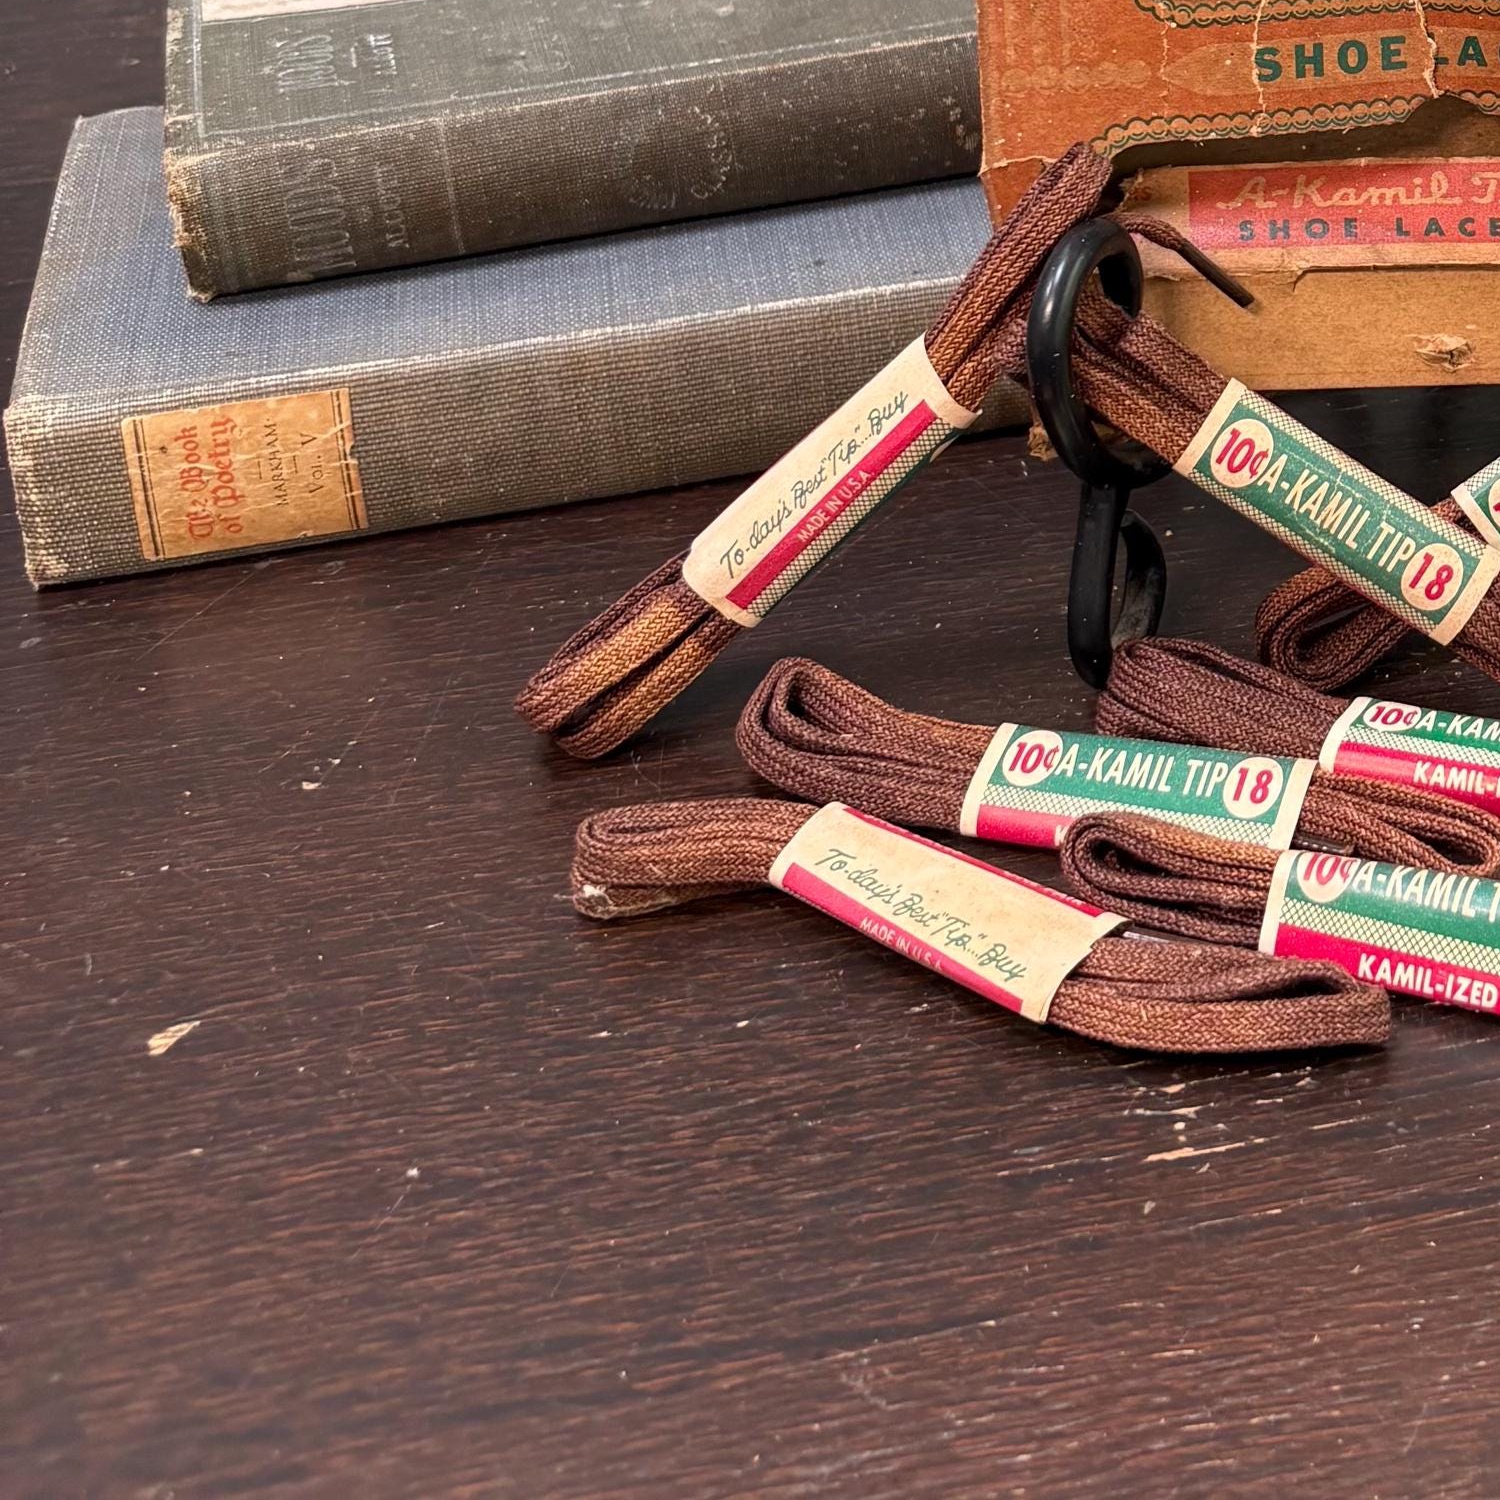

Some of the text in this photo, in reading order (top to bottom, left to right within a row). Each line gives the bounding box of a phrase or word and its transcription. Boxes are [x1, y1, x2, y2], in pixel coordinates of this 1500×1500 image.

[1253, 35, 1407, 82] SHOE
[1216, 170, 1463, 210] A-Kamil
[1238, 217, 1359, 242] SHOE
[174, 424, 209, 493] Book
[790, 464, 828, 509] Best
[867, 390, 909, 435] Buy
[218, 512, 244, 534] of
[797, 509, 831, 542] MADE
[825, 495, 844, 513] IN
[1215, 428, 1454, 601] 10¢ A-KAMIL TIP 18
[1369, 705, 1416, 727] 10¢
[1008, 741, 1274, 805] 10¢ A-KAMIL TIP 18
[1352, 861, 1481, 919] A-KAMIL
[860, 916, 896, 945] MADE
[895, 935, 911, 954] IN
[892, 892, 940, 928] Best
[978, 943, 1028, 983] Buy
[1358, 953, 1499, 1009] KAMIL-IZED
